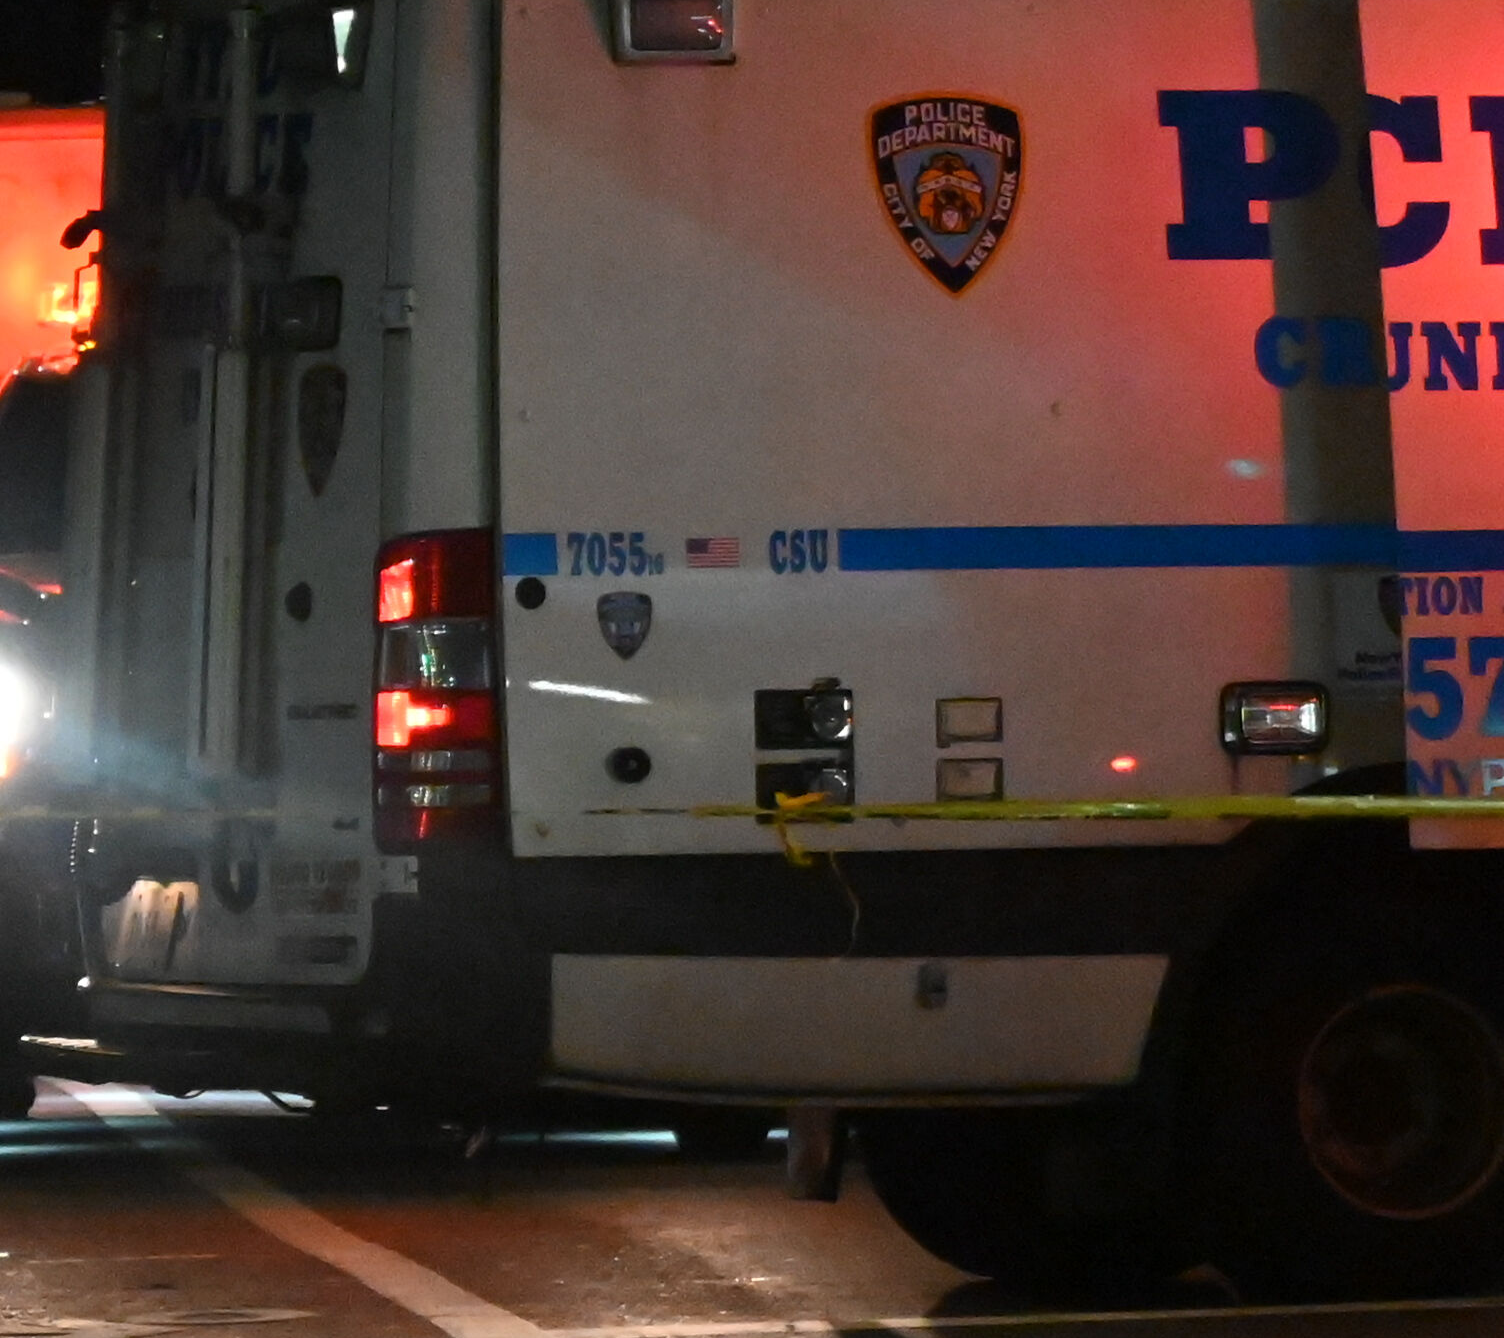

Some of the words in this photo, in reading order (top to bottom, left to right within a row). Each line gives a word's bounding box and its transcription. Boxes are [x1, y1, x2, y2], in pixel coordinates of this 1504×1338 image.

[905, 102, 985, 125] POLICE
[877, 122, 1016, 159] DEPARTMENT
[883, 182, 914, 229] CITY
[910, 236, 936, 261] OF
[965, 228, 998, 272] NEW
[991, 170, 1018, 222] YORK
[566, 532, 645, 576] 7055
[768, 529, 829, 575] CSU
